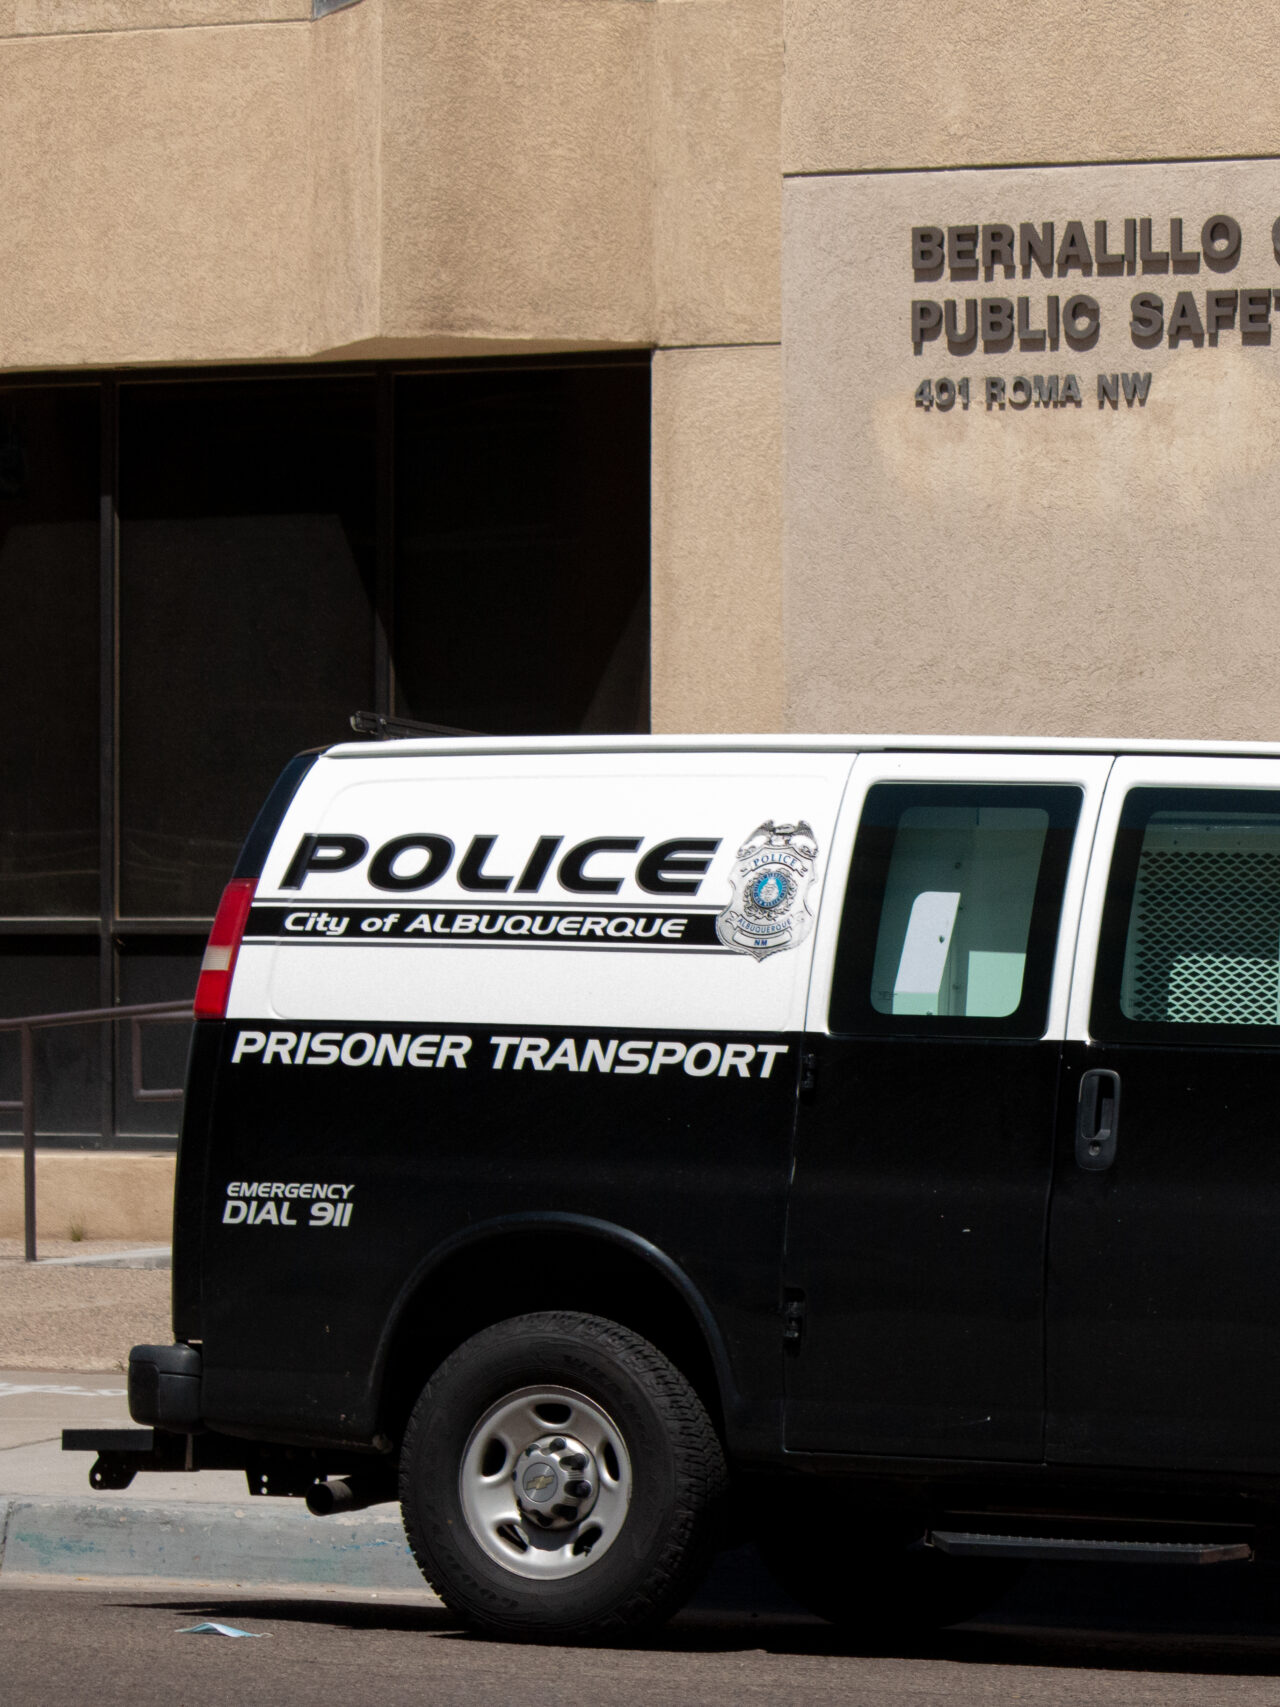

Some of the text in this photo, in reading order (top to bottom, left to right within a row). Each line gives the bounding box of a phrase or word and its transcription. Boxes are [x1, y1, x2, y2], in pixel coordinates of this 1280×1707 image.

[911, 214, 1241, 273] BERNALILLO
[911, 295, 1100, 345] PUBLIC
[914, 371, 1152, 408] 401 ROMA NW
[278, 833, 723, 895] POLICE
[753, 853, 798, 867] POLICE
[284, 912, 688, 939] City of ALBUQUERQUE
[738, 918, 792, 934] ALBUQUERQUE
[231, 1031, 789, 1079] PRISONER TRANSPORT
[227, 1182, 355, 1200] EMERGENCY
[222, 1201, 354, 1228] DIAL 911
